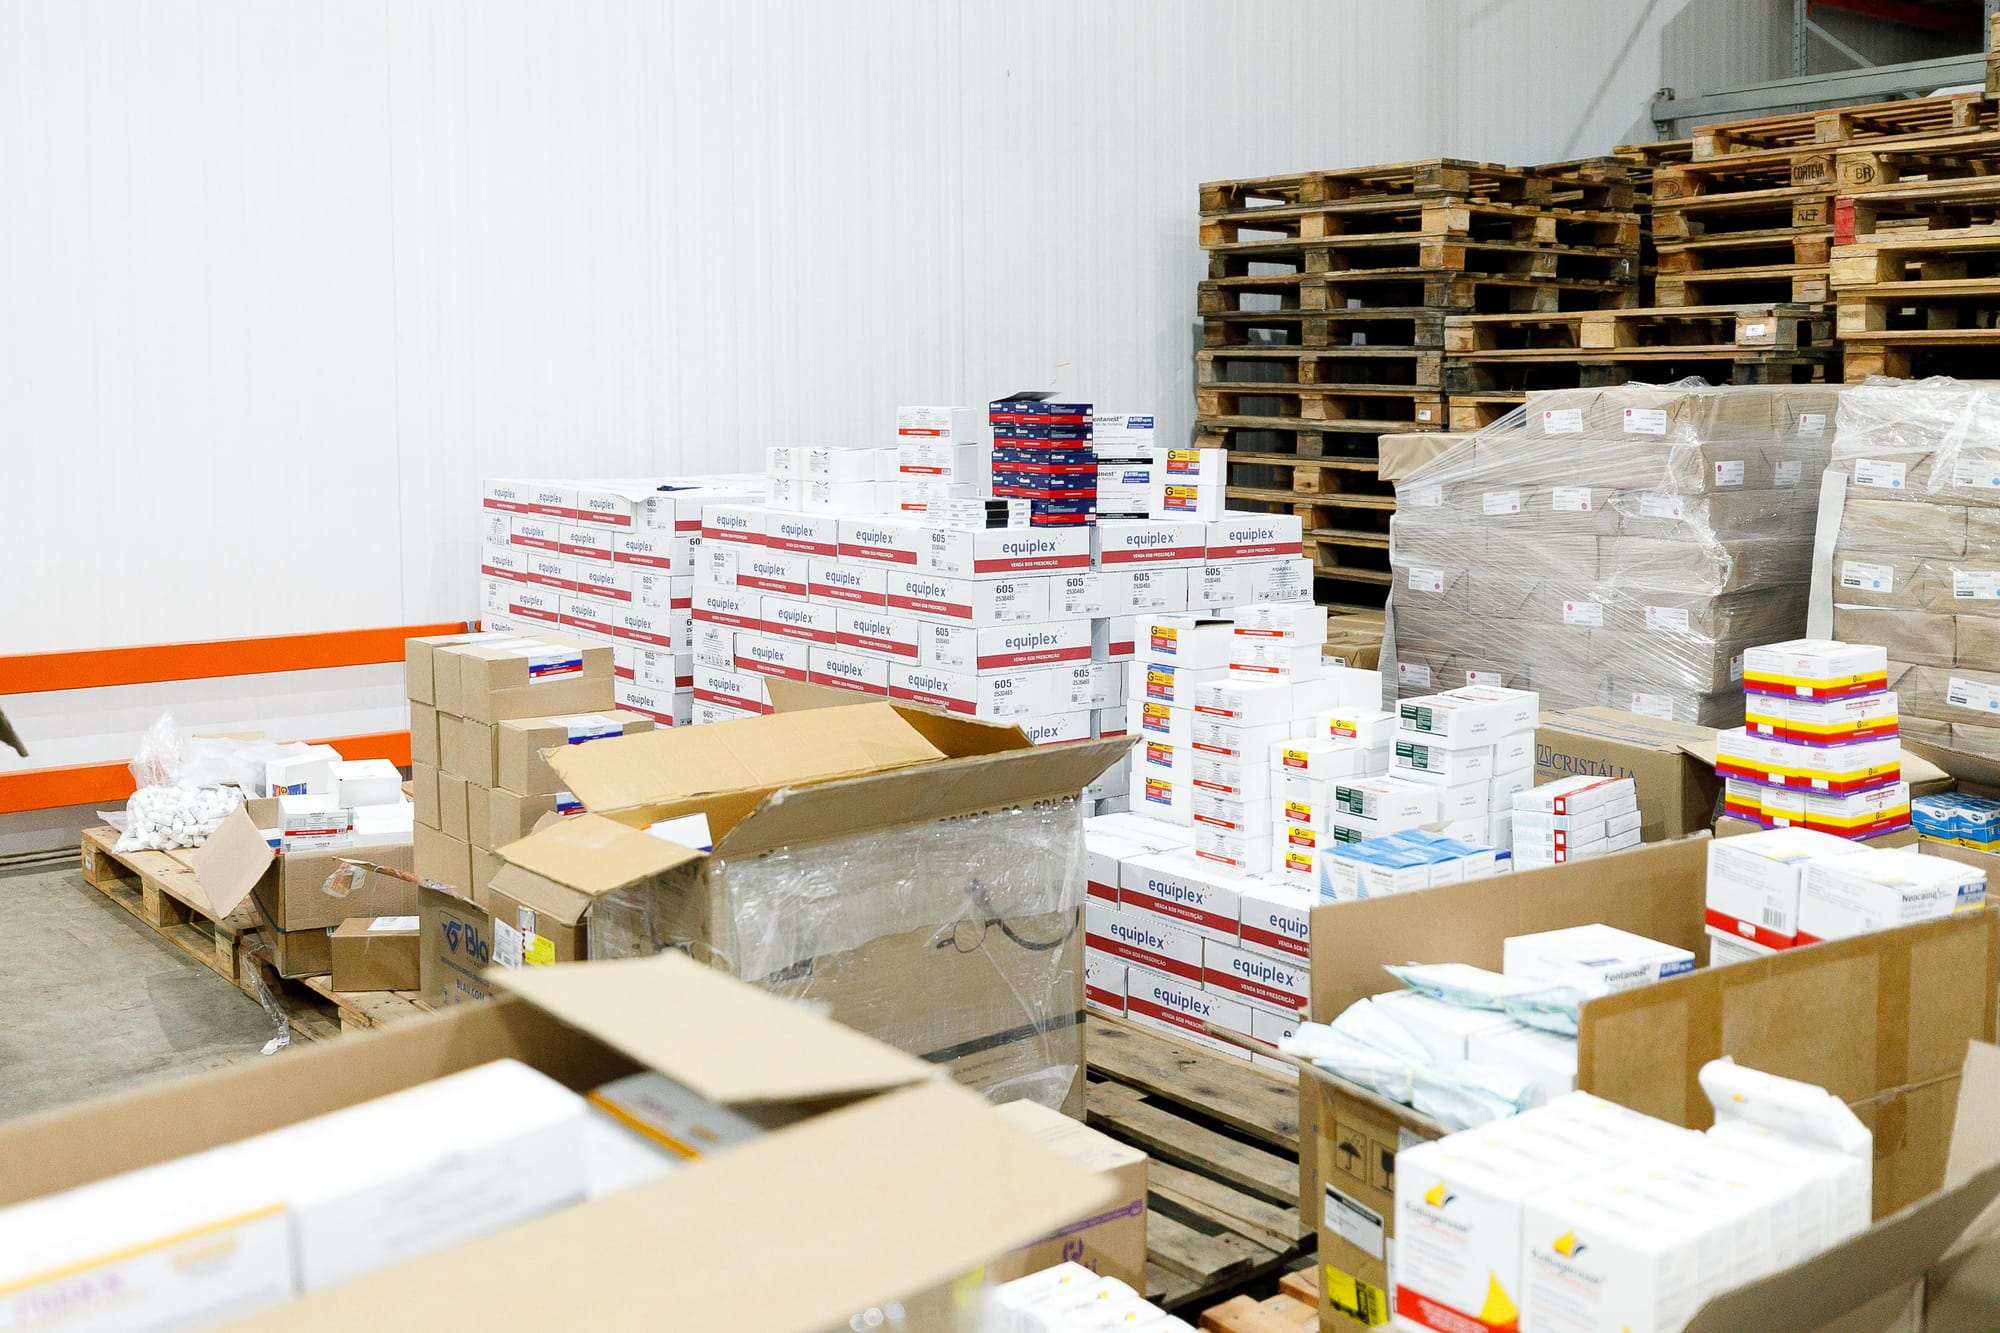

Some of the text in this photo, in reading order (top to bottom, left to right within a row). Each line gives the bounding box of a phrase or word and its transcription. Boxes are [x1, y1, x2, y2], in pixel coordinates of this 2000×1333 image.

[1794, 163, 1824, 180] CORTEVA
[1856, 167, 1870, 180] BR
[1168, 450, 1175, 459] G
[494, 487, 515, 499] equiplex
[1165, 486, 1173, 496] G
[539, 492, 561, 504] equiplex
[590, 497, 614, 510] equiplex
[717, 515, 747, 528] equiplex
[522, 526, 544, 537] equiplex
[782, 522, 813, 537] equiplex
[1229, 528, 1274, 542] equiplex
[571, 532, 595, 544] equiplex
[856, 529, 892, 544] equiplex
[932, 534, 945, 543] 605
[1126, 531, 1174, 546] equiplex
[626, 538, 652, 552] equiplex
[1002, 539, 1055, 555] equiplex
[492, 554, 513, 566] equiplex
[714, 553, 724, 561] 605
[539, 562, 561, 575] equiplex
[754, 562, 785, 576] equiplex
[1205, 568, 1221, 576] 605
[589, 572, 614, 584] equiplex
[826, 570, 860, 585] equiplex
[1067, 578, 1084, 587] 605
[1134, 573, 1150, 581] 605
[906, 581, 946, 597] equiplex
[996, 584, 1014, 593] 605
[520, 593, 542, 606] equiplex
[707, 596, 739, 611] equiplex
[572, 604, 596, 617] equiplex
[778, 607, 812, 624] equiplex
[625, 616, 651, 630] equiplex
[854, 619, 890, 636] equiplex
[936, 628, 949, 636] 605
[1151, 626, 1157, 635] G
[1006, 633, 1057, 649] equiplex
[752, 646, 784, 661] equiplex
[1036, 652, 1060, 660] PRESCRIÇÃO
[827, 660, 862, 677] equiplex
[1074, 669, 1089, 678] 605
[908, 673, 948, 691] equiplex
[1148, 672, 1154, 681] G
[709, 676, 740, 691] equiplex
[995, 679, 1012, 689] 605
[627, 693, 654, 706] equiplex
[1143, 703, 1149, 713] G
[1336, 719, 1341, 727] G
[1027, 724, 1058, 743] iplex
[1552, 753, 1637, 786] CRISTÁLIA
[1149, 879, 1202, 904] equiplex
[1168, 906, 1177, 914] SOB
[1178, 907, 1203, 921] PRESCRIÇÃO
[1270, 914, 1308, 938] equip
[1111, 923, 1164, 949] equiplex
[464, 923, 489, 964] Bla
[1278, 940, 1300, 951] VENDA SOB
[1141, 952, 1166, 967] PRESCRIÇÃO
[1233, 959, 1293, 986] equiplex
[1154, 987, 1209, 1016] equiplex
[1255, 987, 1265, 995] SOB
[1265, 989, 1295, 1005] PRESCRIÇÃO
[1161, 1012, 1174, 1020] VENDA
